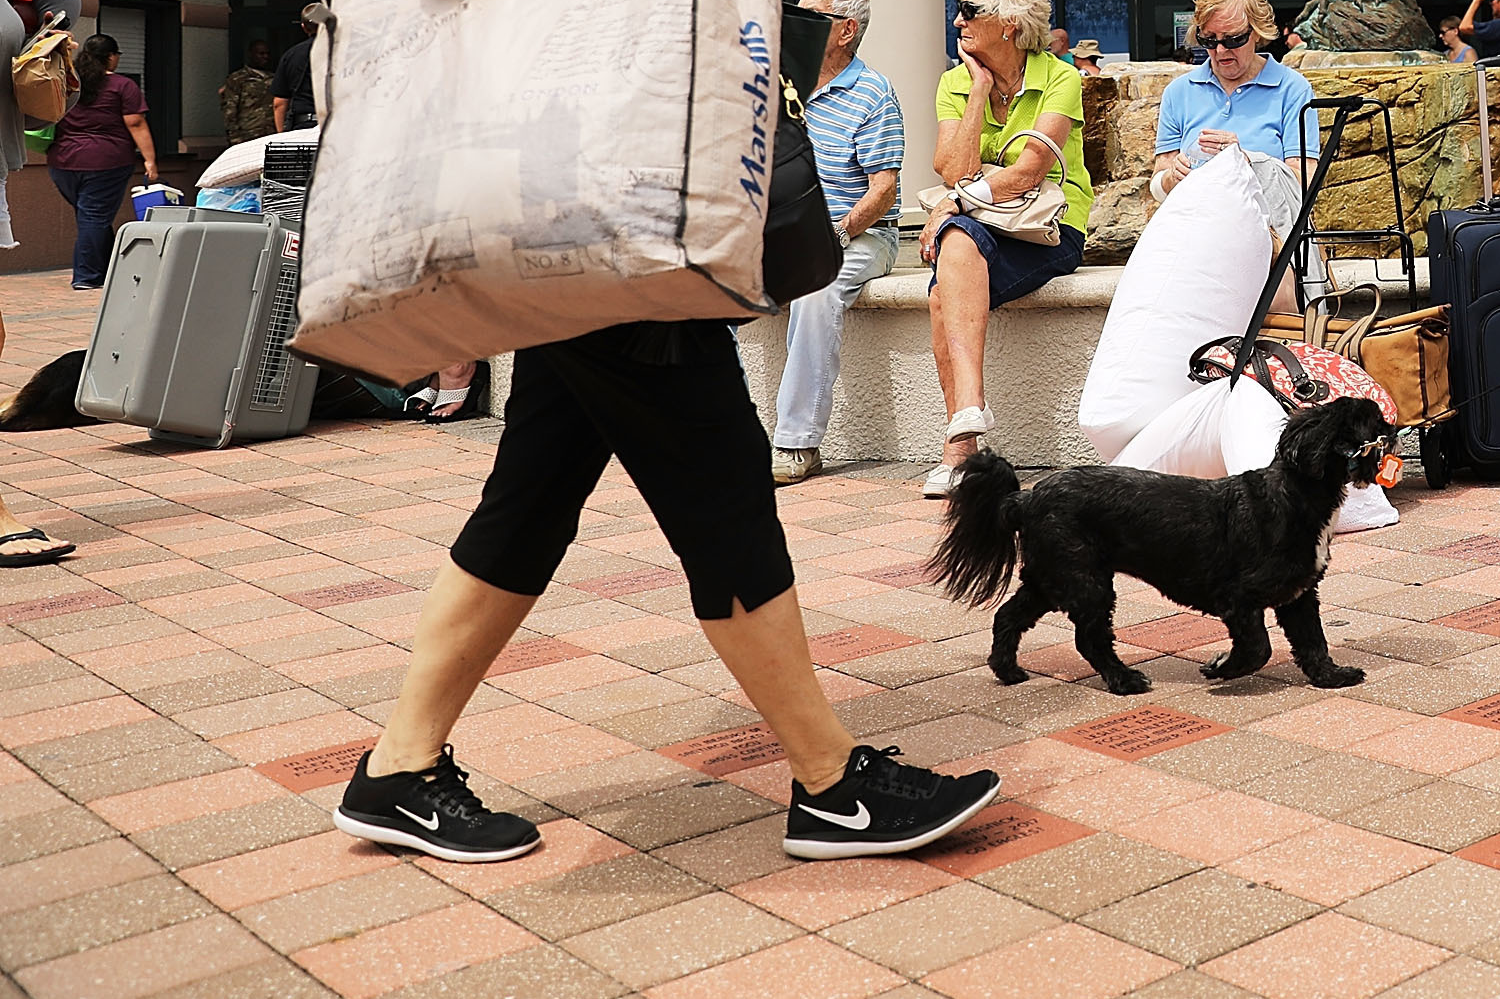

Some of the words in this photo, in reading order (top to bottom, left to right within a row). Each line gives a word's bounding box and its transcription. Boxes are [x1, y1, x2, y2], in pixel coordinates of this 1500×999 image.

[740, 21, 769, 219] Marshlls
[1087, 714, 1138, 730] MEMORY
[1135, 712, 1171, 724] ESTES
[1107, 734, 1151, 749] FAMILY
[1150, 719, 1198, 735] MEMBER
[1122, 733, 1182, 753] DECEMBER
[305, 745, 366, 763] MEMORY
[700, 753, 740, 764] CROSS
